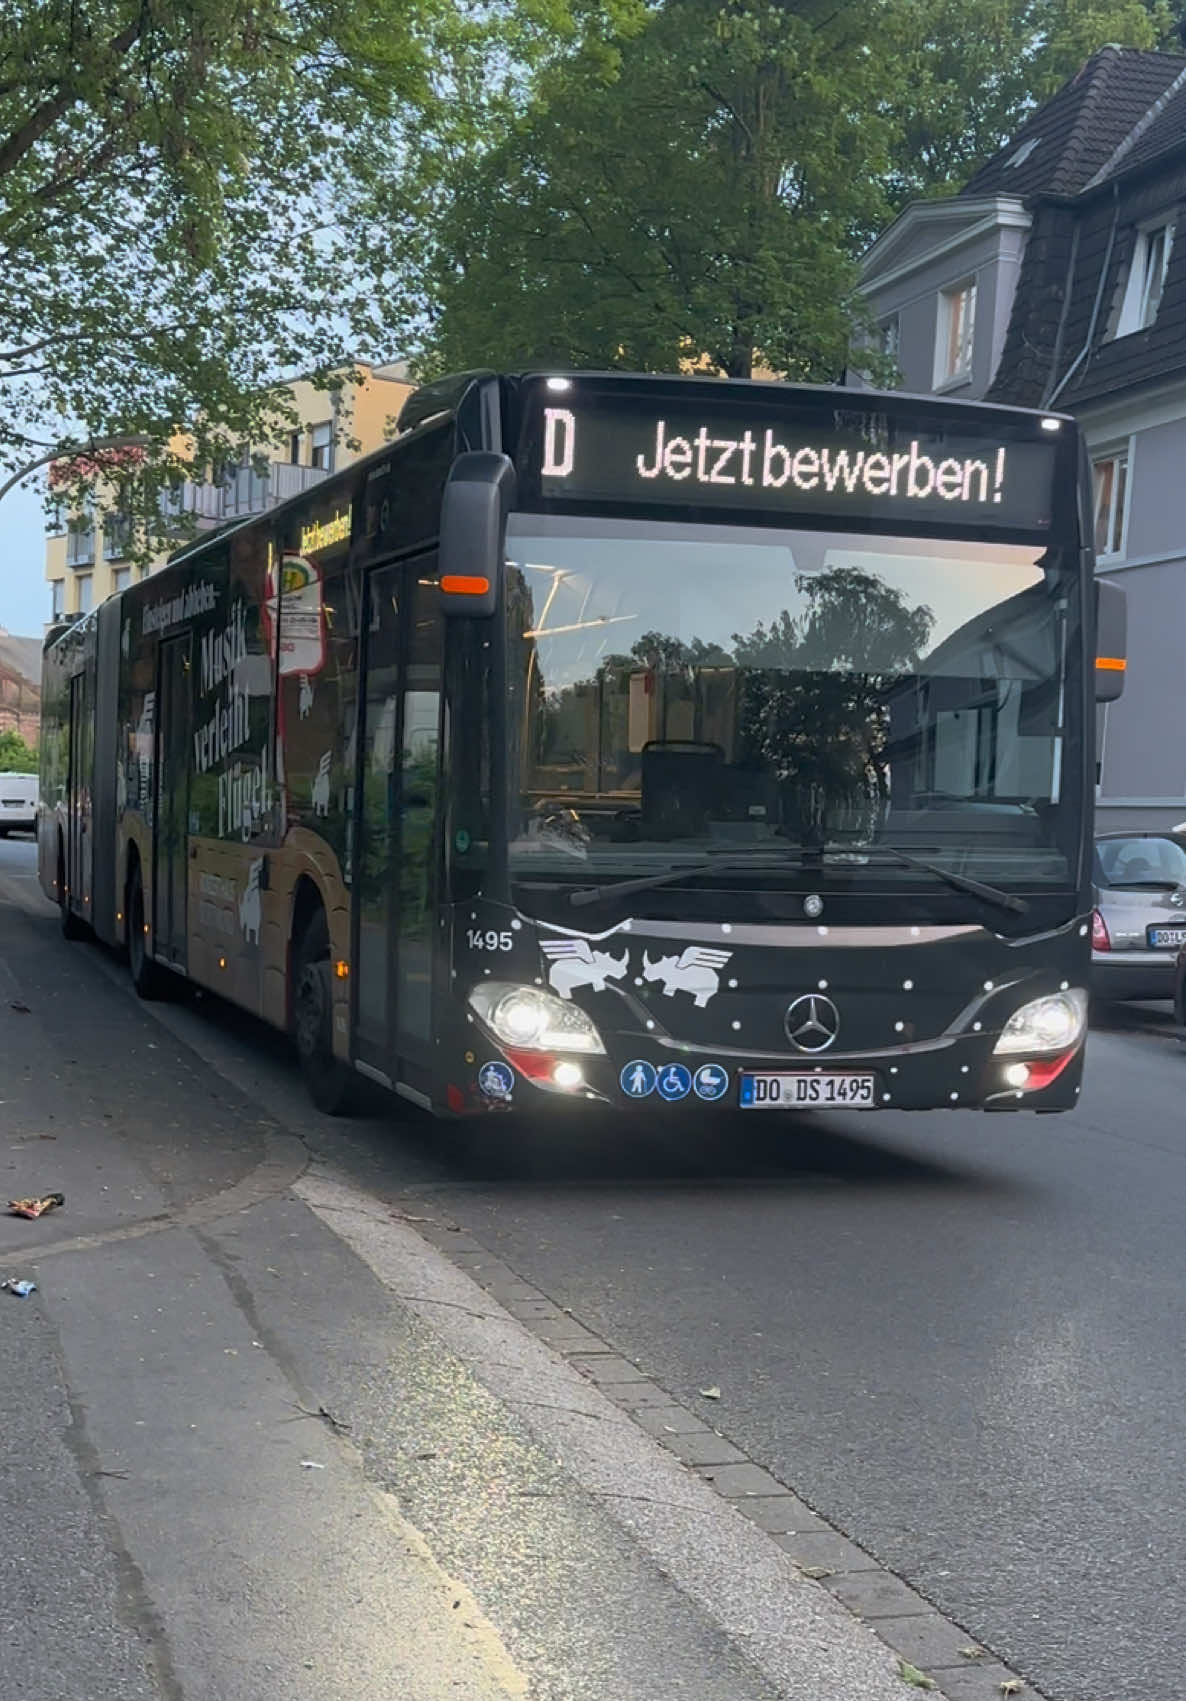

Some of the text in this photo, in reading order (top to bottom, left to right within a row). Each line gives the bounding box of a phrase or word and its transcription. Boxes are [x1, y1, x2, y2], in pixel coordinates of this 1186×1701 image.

[541, 408, 1006, 502] D Jetzt bewerben!
[200, 597, 247, 698] Musik
[194, 683, 250, 775] verleiht
[466, 930, 513, 951] 1495
[756, 1079, 871, 1101] DO DS 1495
